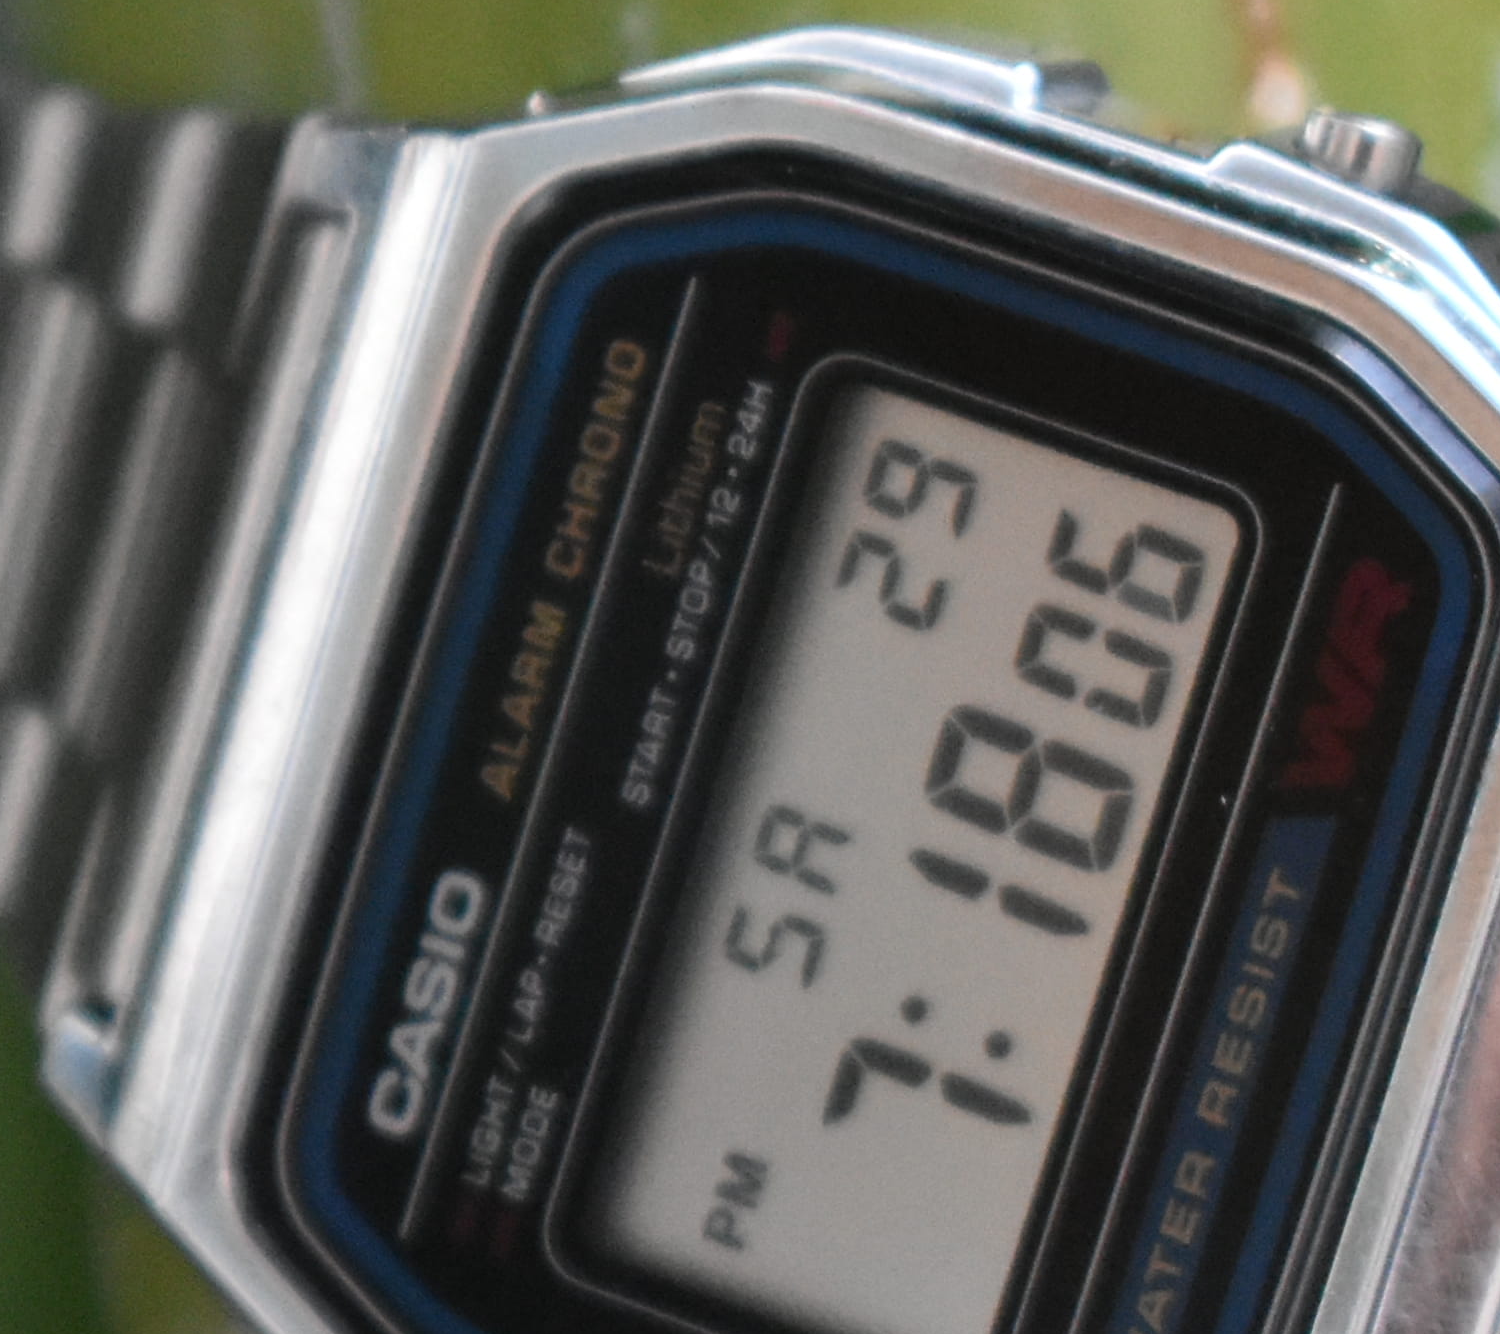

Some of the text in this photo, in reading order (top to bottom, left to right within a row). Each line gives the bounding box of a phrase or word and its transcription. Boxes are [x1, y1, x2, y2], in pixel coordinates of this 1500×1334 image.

[480, 339, 647, 802] ALARM CHRONO
[642, 400, 726, 577] Lithium
[836, 438, 979, 632] 29
[1278, 557, 1414, 789] WR
[725, 804, 852, 989] SA
[367, 869, 487, 1137] CASIO
[1196, 867, 1300, 1129] RESIST
[501, 1084, 559, 1202] MODE
[702, 1150, 769, 1252] PM
